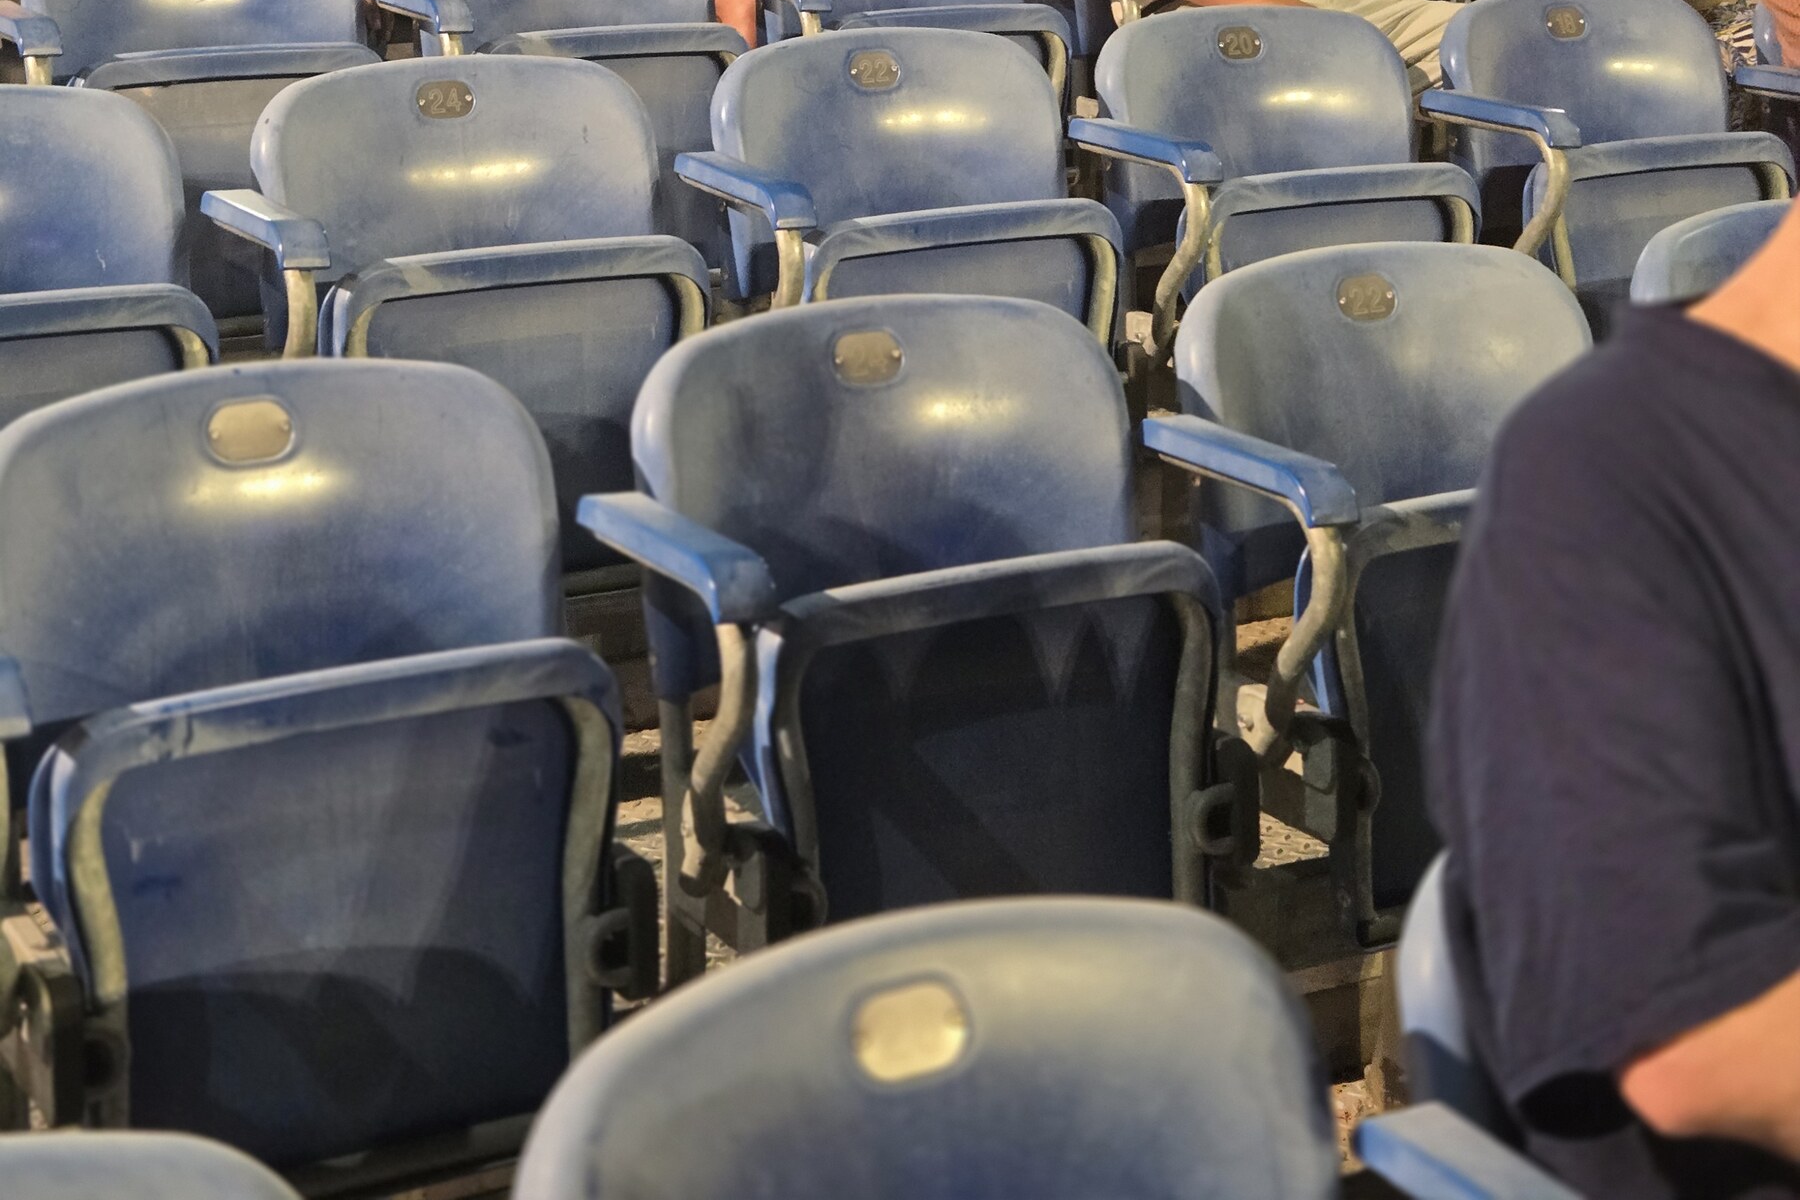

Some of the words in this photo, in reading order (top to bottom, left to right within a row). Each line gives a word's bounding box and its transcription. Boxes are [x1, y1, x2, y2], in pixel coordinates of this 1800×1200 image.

[1228, 31, 1252, 55] 20
[858, 59, 889, 84] 22
[428, 87, 462, 115] 24
[1349, 283, 1386, 315] 22
